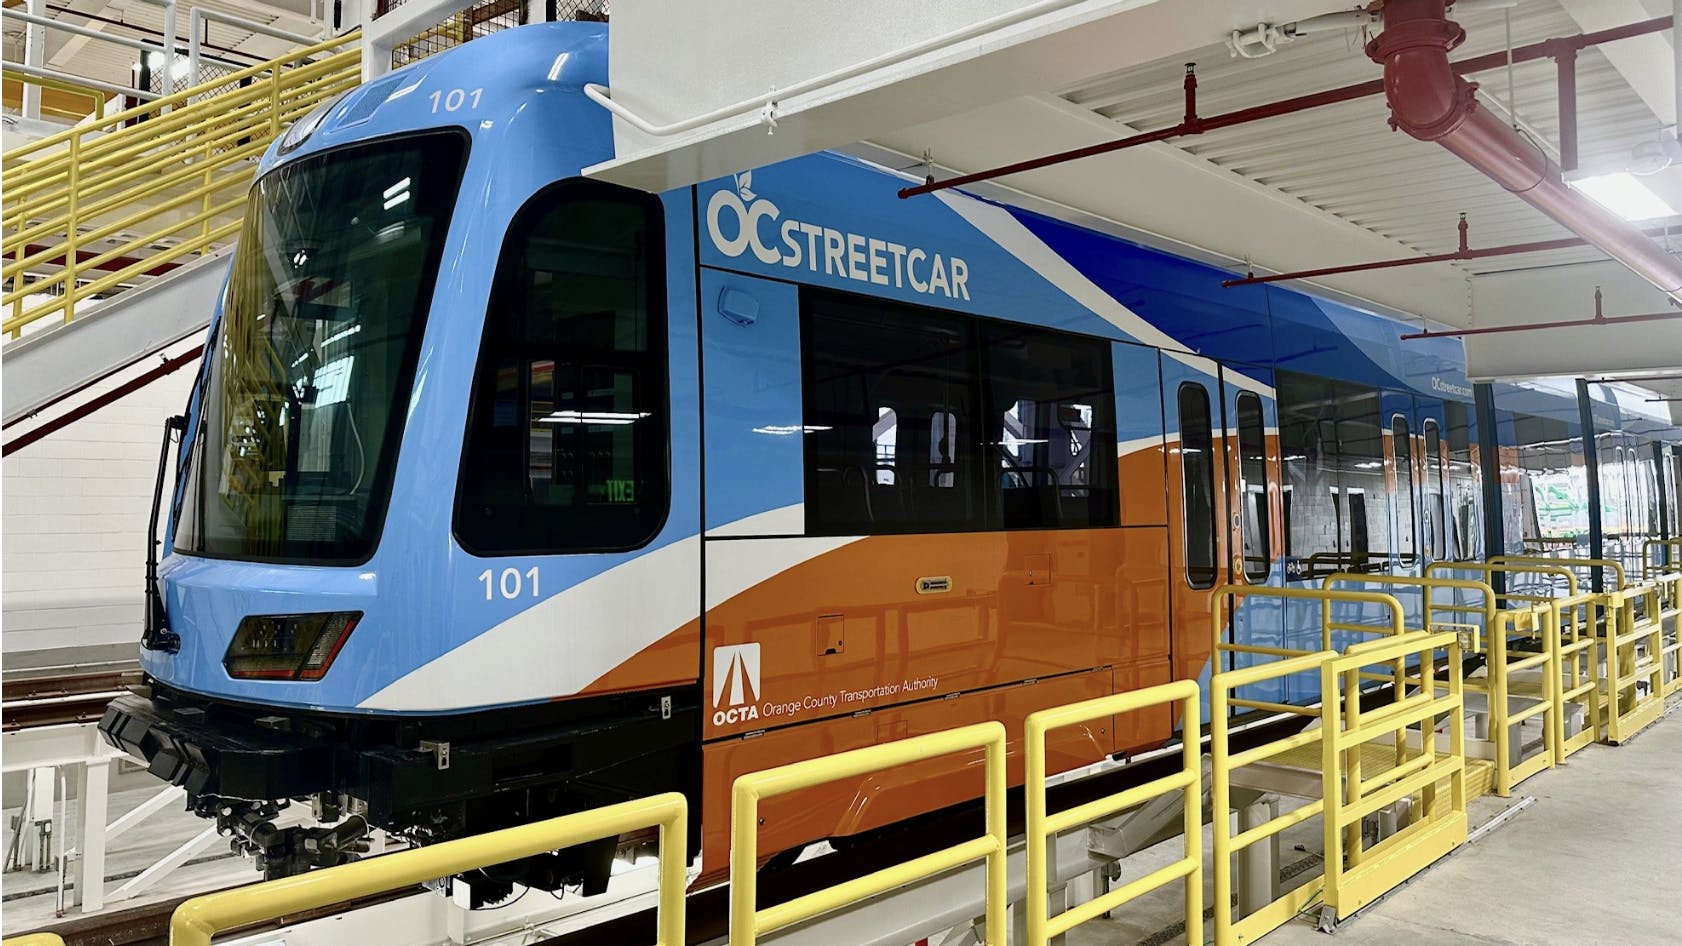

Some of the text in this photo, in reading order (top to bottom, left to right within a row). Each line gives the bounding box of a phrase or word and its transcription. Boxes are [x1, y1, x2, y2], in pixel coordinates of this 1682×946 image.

[429, 88, 484, 114] 101
[478, 566, 539, 601] 101
[762, 675, 938, 717] Orange County Transportation Authority
[712, 705, 759, 726] OCTA
